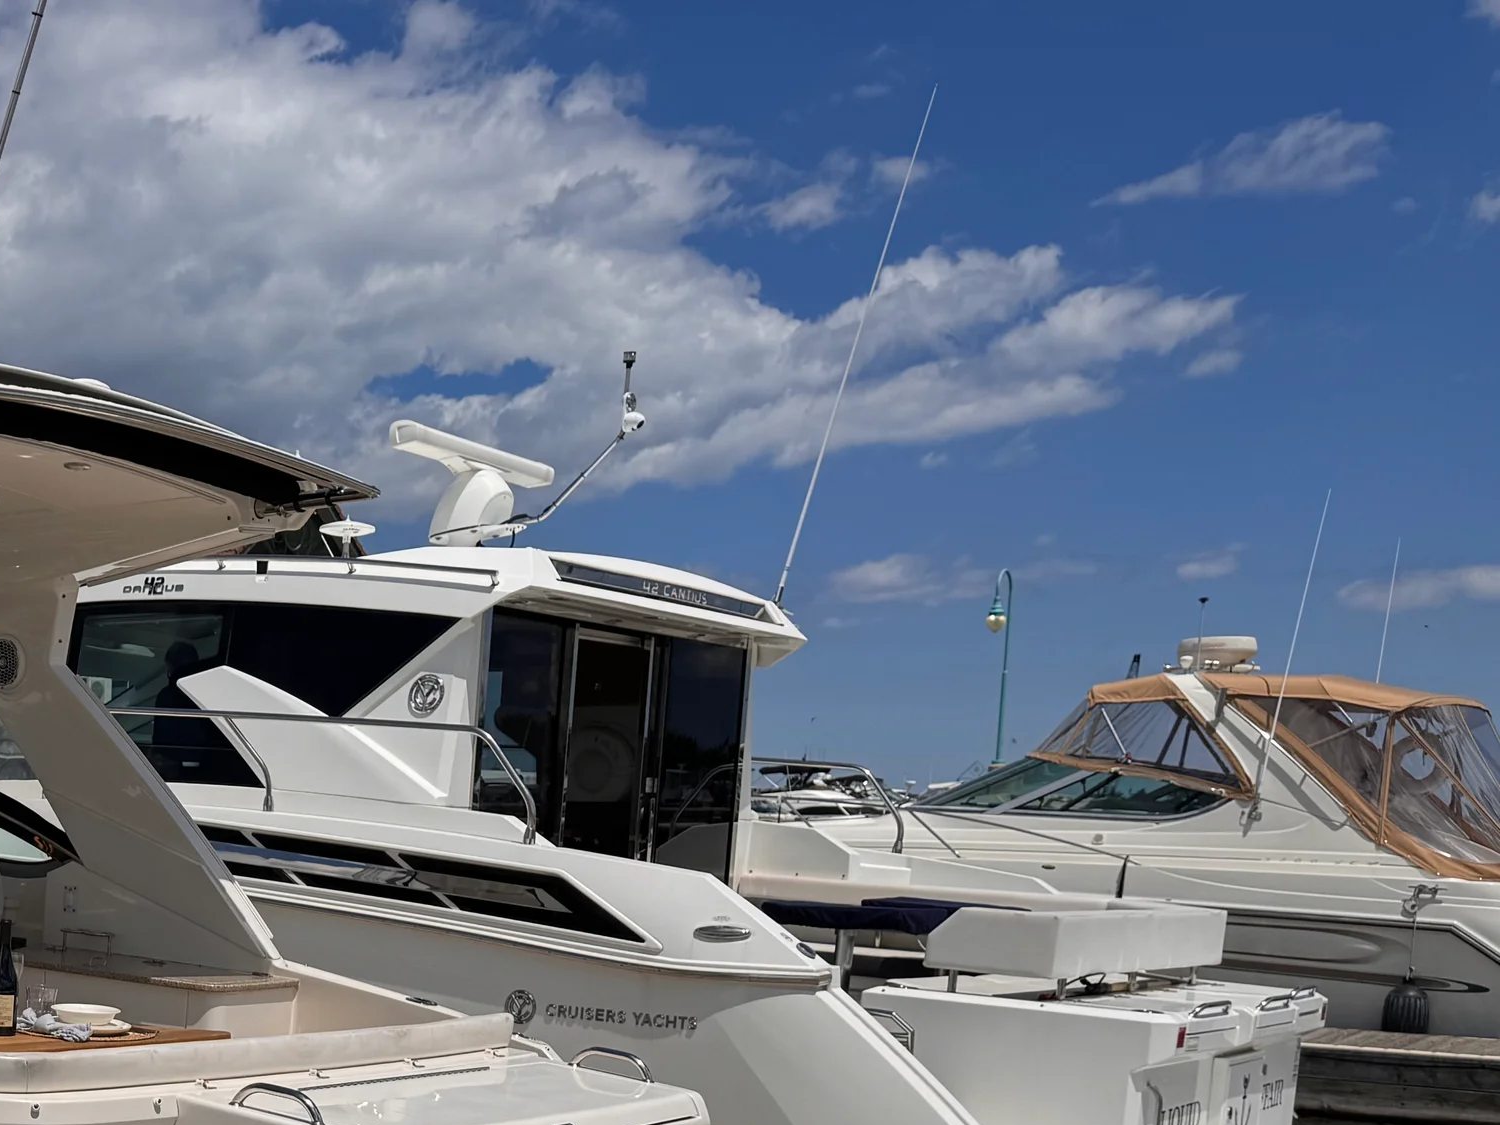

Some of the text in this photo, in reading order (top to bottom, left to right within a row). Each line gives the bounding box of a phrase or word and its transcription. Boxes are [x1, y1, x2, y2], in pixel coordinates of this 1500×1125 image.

[642, 580, 708, 605] 42 CANTIUS
[545, 1003, 698, 1030] CRUISERS YACHTS
[1261, 1079, 1284, 1110] FAIR
